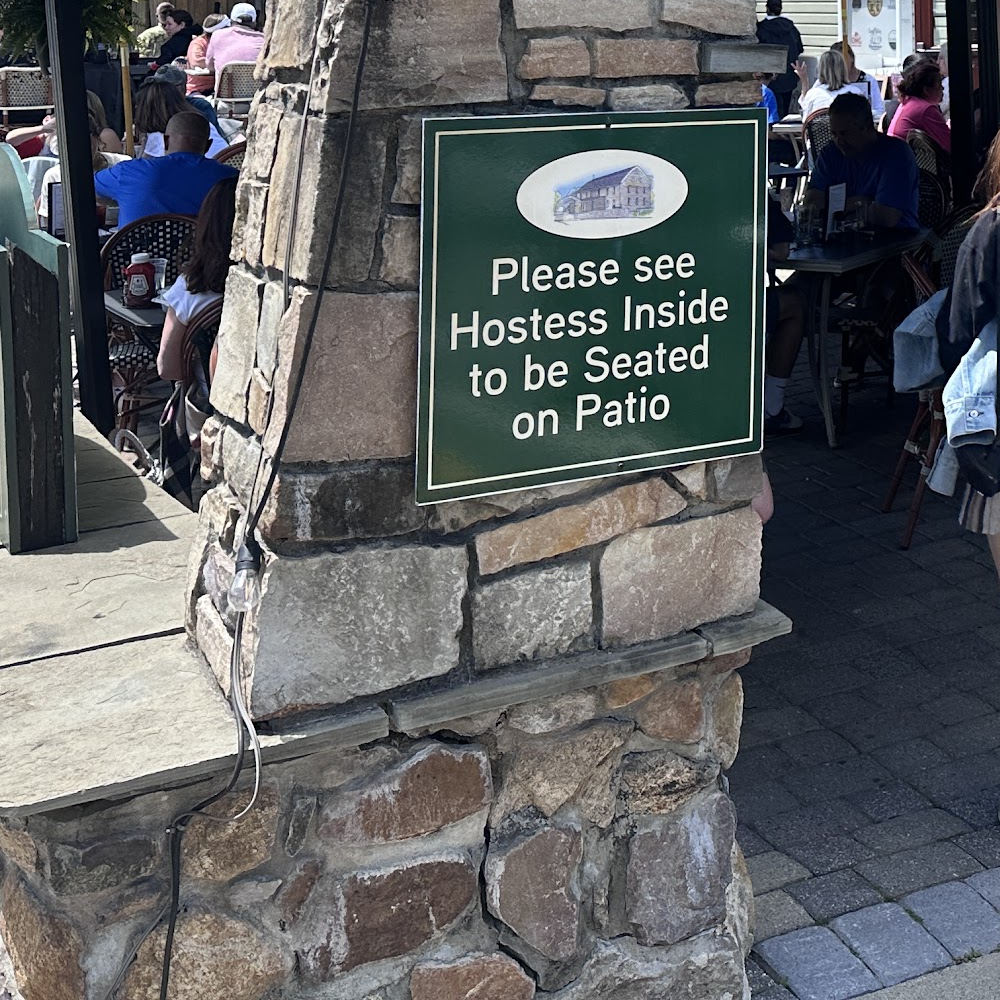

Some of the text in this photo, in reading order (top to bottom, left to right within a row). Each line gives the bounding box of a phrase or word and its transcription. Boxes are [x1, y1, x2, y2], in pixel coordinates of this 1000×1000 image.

[492, 253, 695, 296] Please see
[450, 288, 729, 351] Hostess Inside
[469, 335, 709, 398] to be Seated
[512, 386, 671, 440] on Patio
